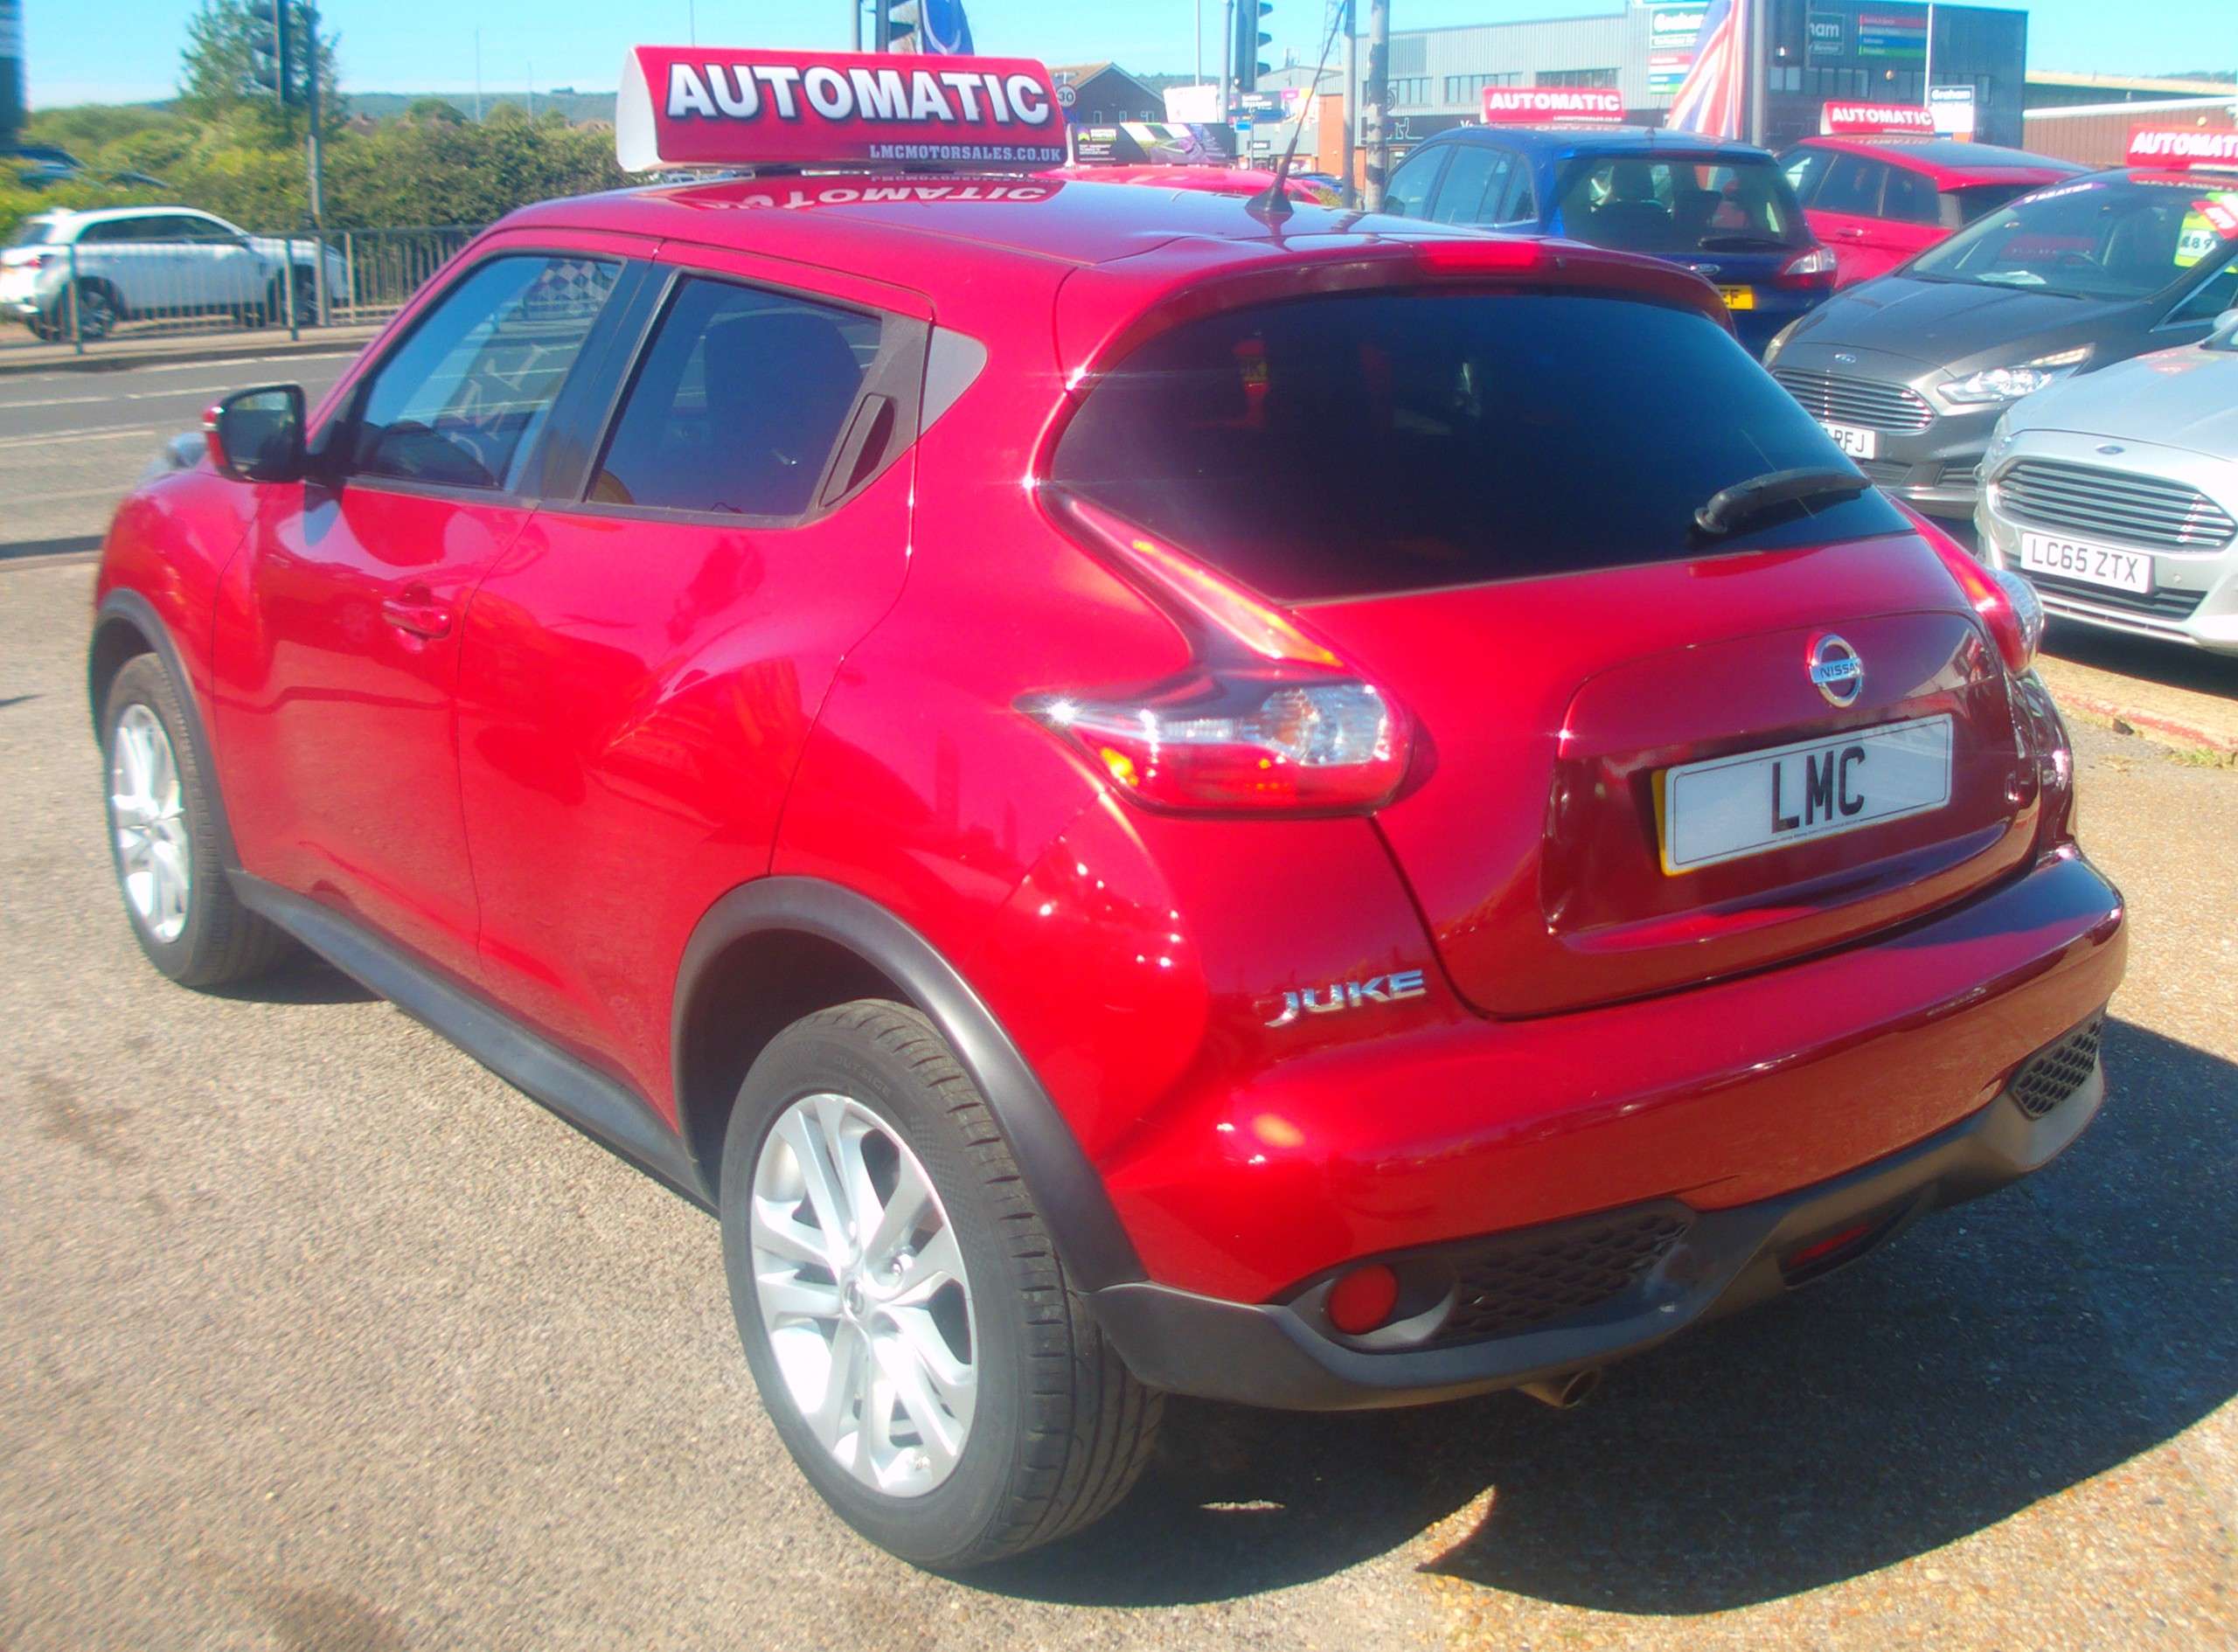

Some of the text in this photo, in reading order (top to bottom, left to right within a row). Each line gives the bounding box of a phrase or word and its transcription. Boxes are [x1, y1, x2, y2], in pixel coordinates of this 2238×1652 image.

[666, 63, 1049, 125] AUTOMATIC
[1058, 91, 1075, 101] 30
[1490, 93, 1620, 111] AUTOMATIC
[1831, 107, 1932, 126] AUTOMATIC
[869, 144, 1061, 162] LMCMOTORSALES.CO.UK
[2130, 131, 2238, 158] AUTOMAT
[1824, 427, 1865, 453] RFJ
[2032, 538, 2138, 584] LC65 ZTX
[1771, 746, 1866, 834] LMC
[1265, 969, 1427, 1028] JUKE
